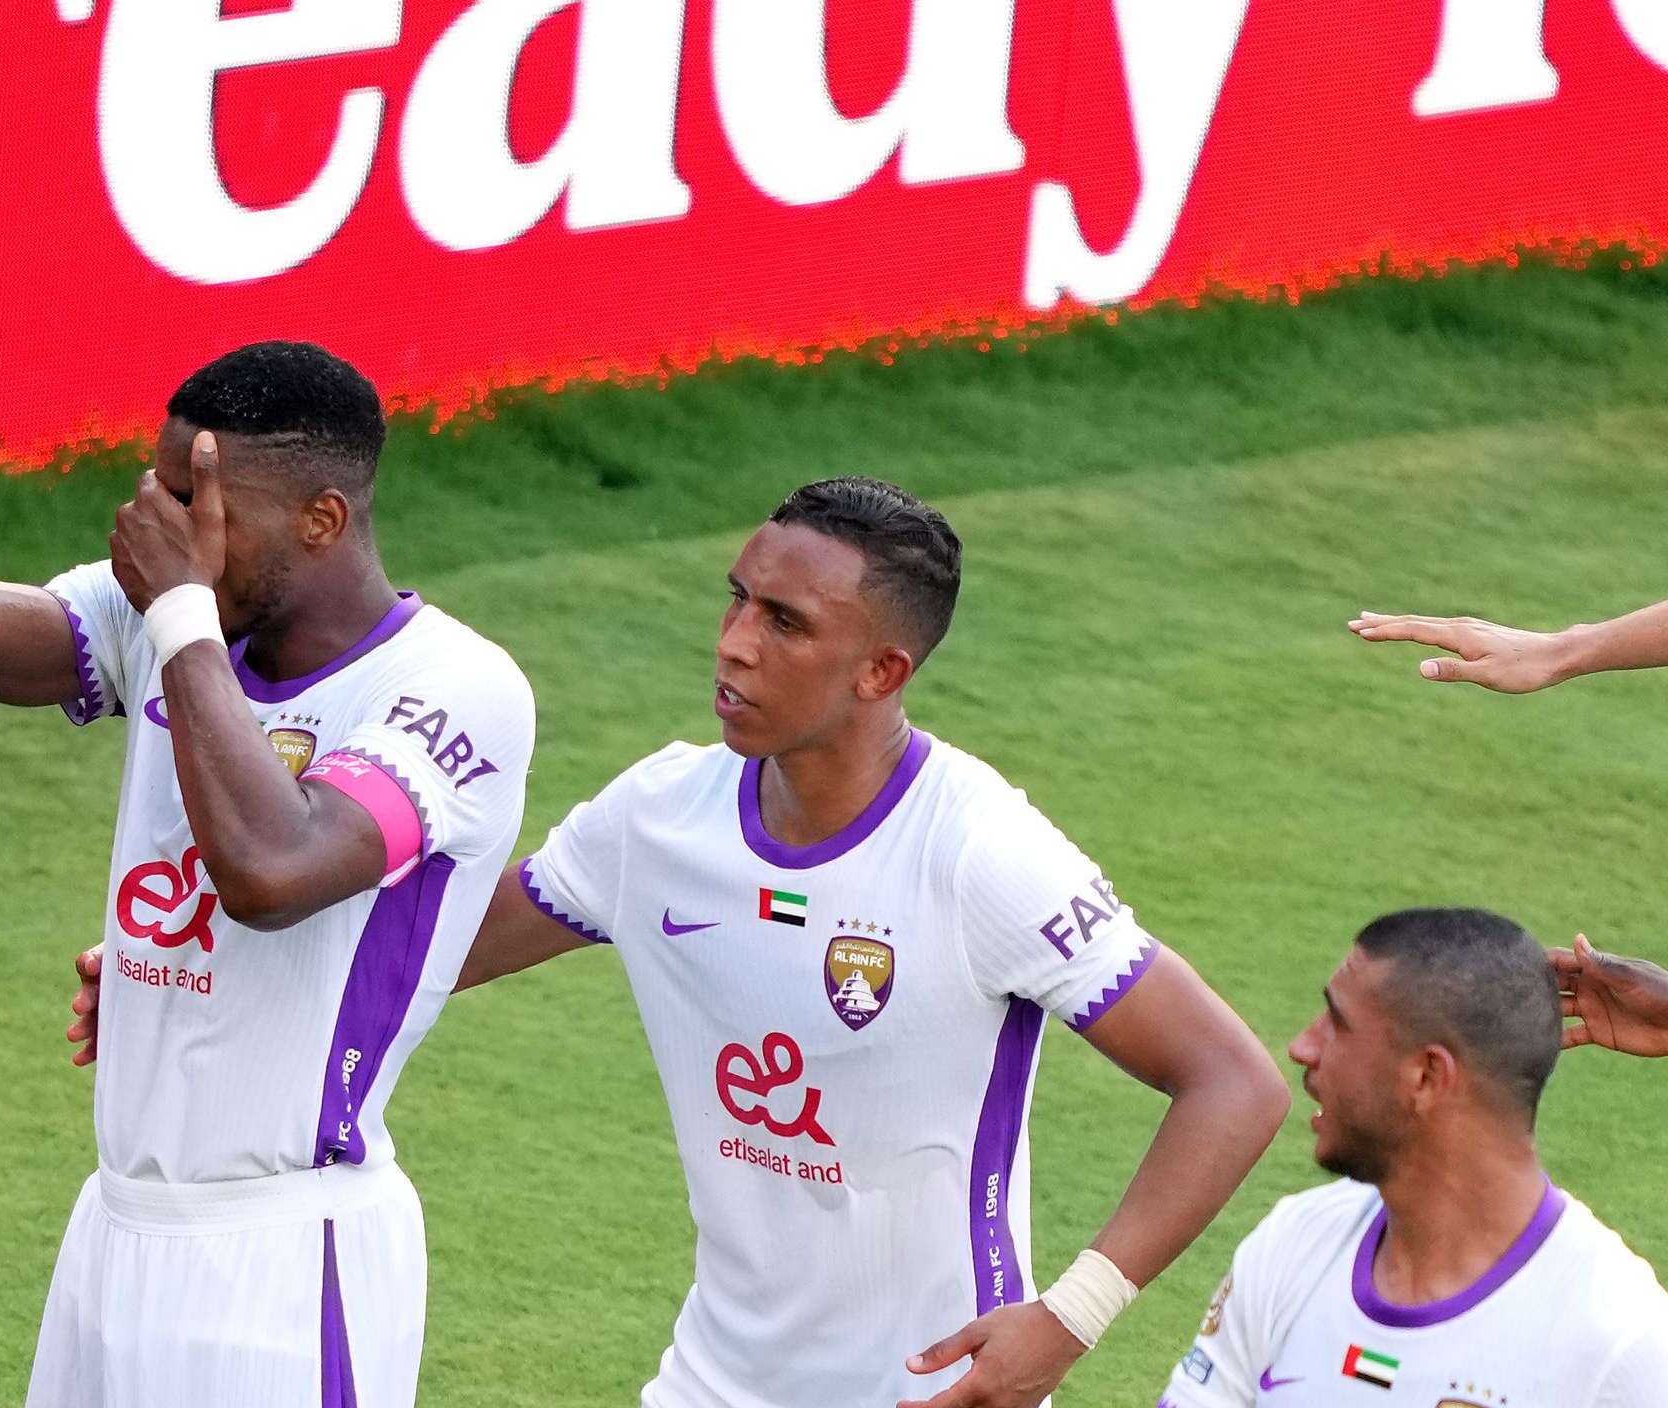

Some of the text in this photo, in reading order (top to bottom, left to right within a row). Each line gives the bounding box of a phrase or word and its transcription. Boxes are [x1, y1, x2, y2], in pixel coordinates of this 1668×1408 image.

[117, 950, 212, 994] tisalat and
[869, 955, 885, 968] FC
[338, 1121, 352, 1142] FC
[719, 1137, 843, 1184] etisalat and
[985, 1172, 1000, 1219] 1968
[989, 1246, 1002, 1268] FC
[993, 1270, 1004, 1297] AIN
